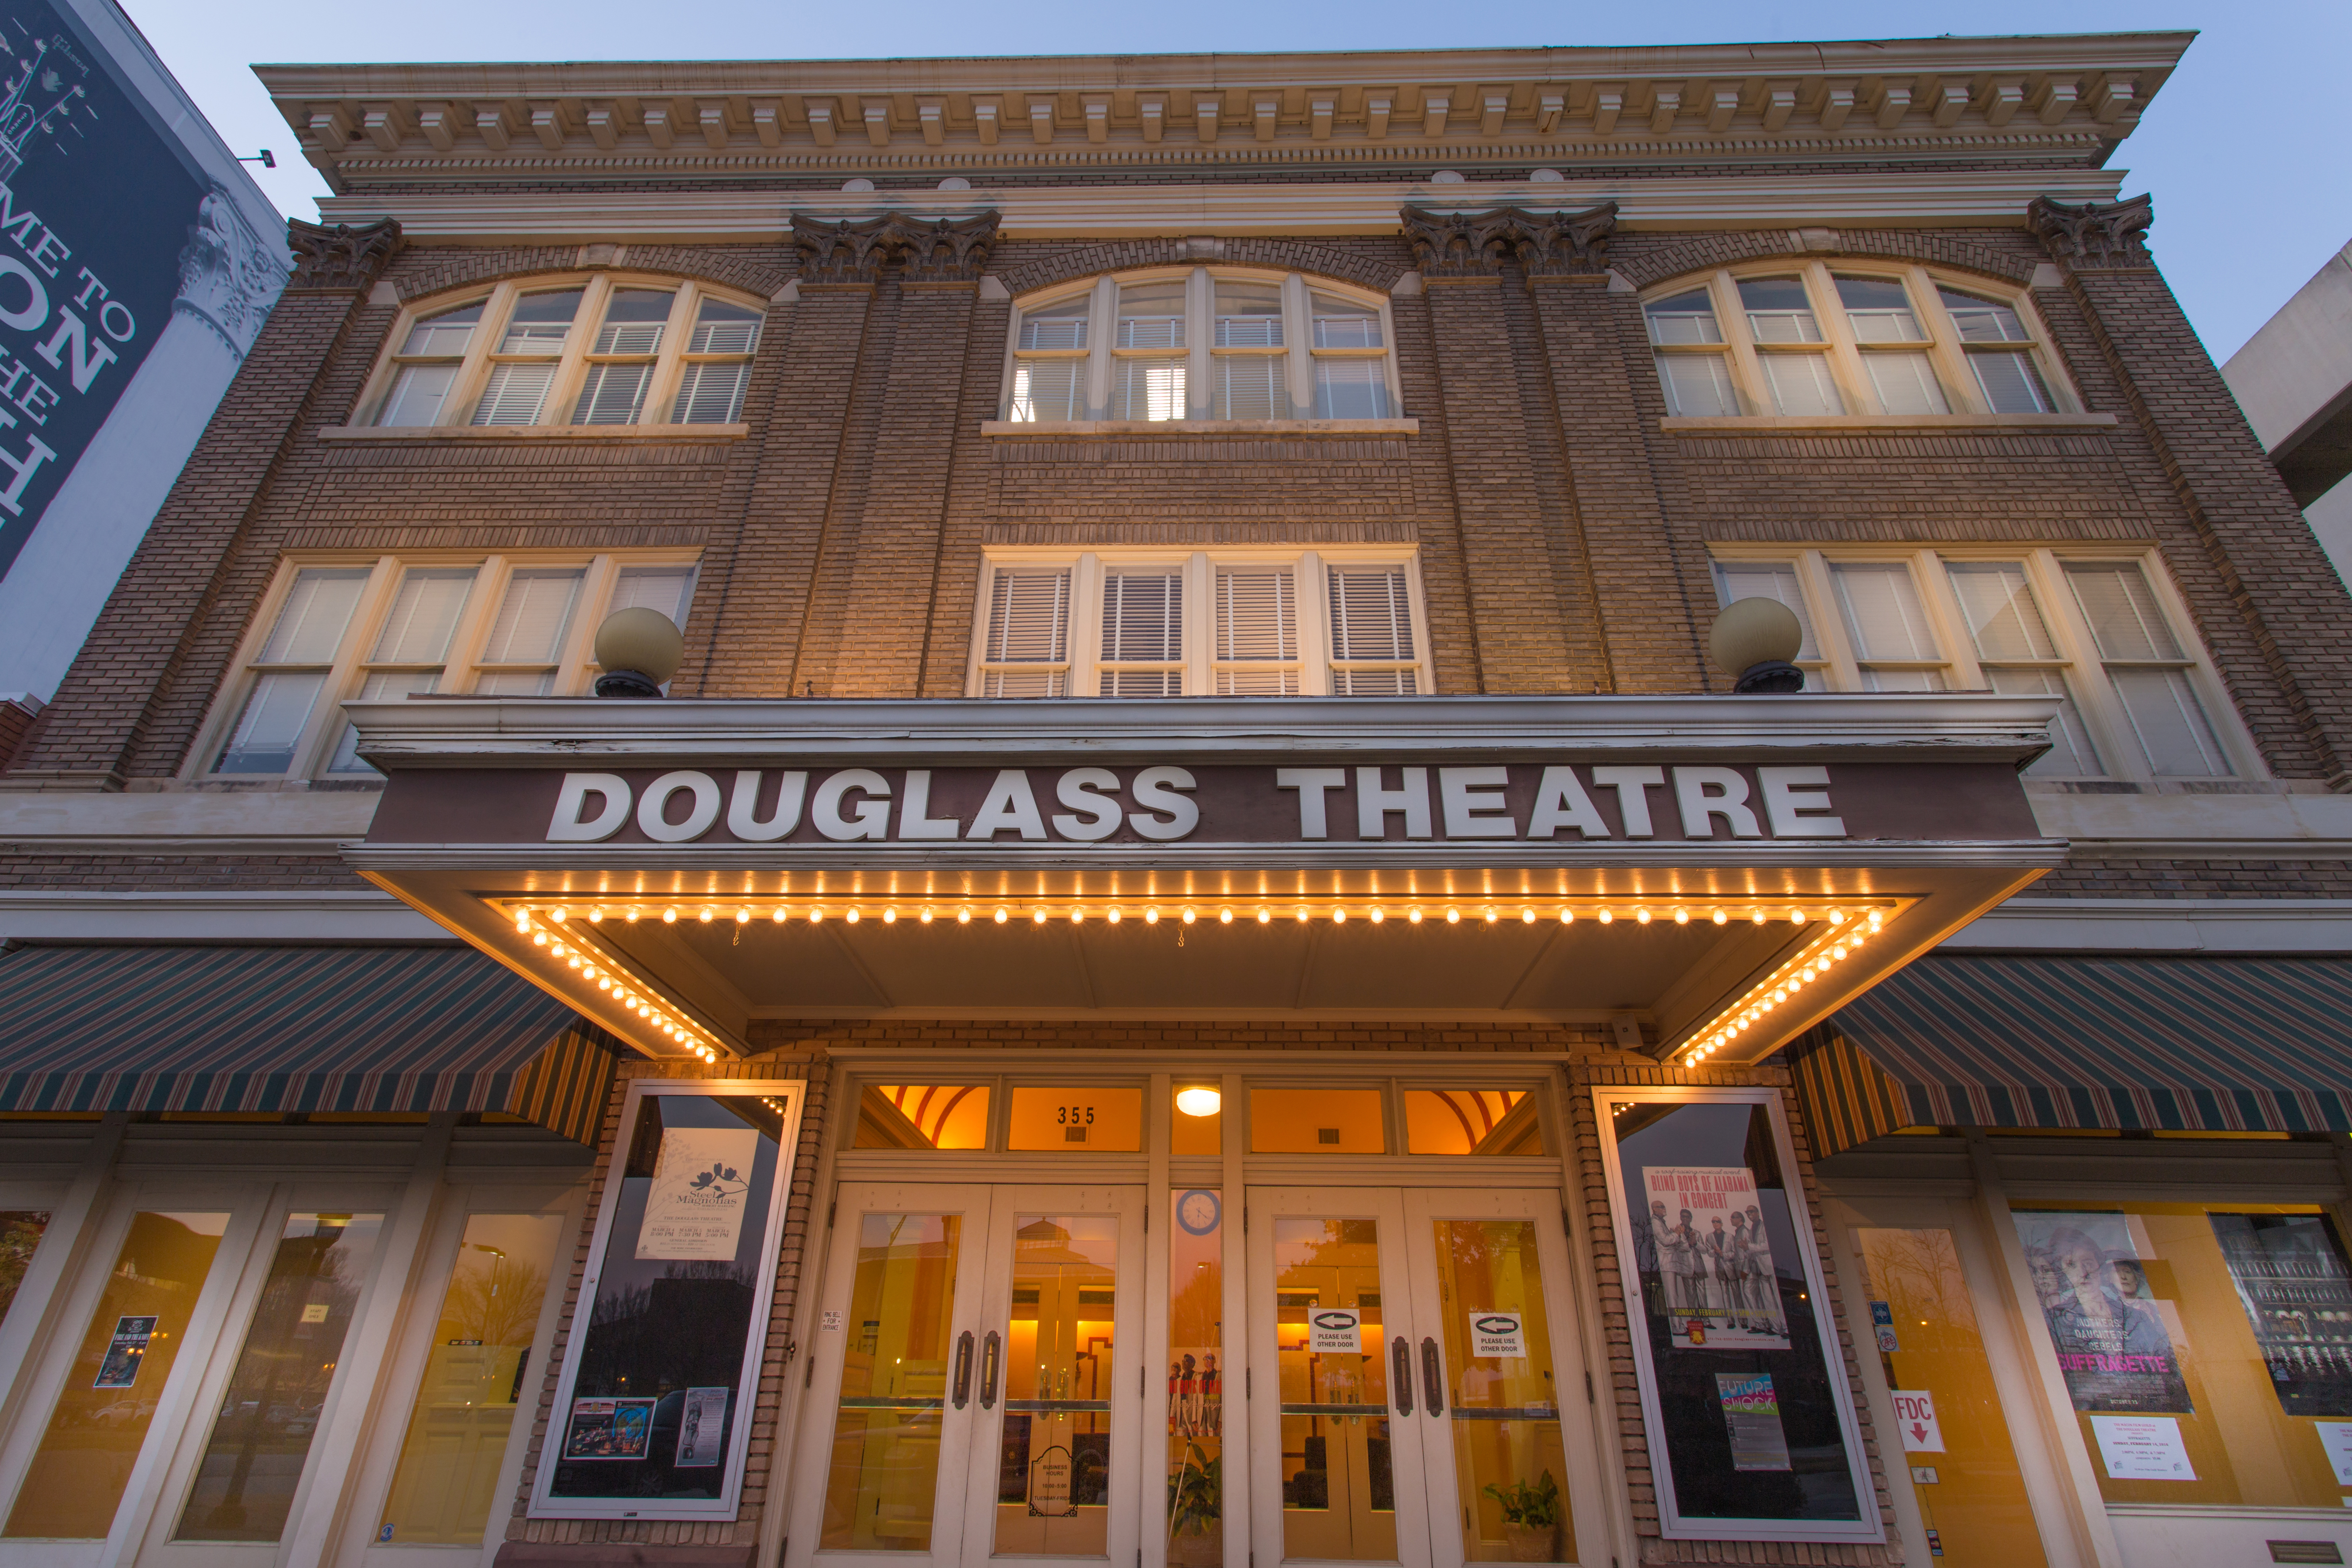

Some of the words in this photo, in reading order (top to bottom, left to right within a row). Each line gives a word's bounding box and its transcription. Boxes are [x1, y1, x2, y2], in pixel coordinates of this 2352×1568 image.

[50, 34, 90, 78] Gibson
[73, 266, 136, 342] TO
[545, 765, 1200, 843] DOUGLASS
[1276, 765, 1848, 840] THEATRE
[1057, 1106, 1095, 1125] 355
[1650, 1175, 1676, 1191] BLIND
[1677, 1175, 1699, 1191] BOYS
[1701, 1176, 1712, 1192] OF
[1714, 1176, 1750, 1192] ALABAMA
[676, 1195, 737, 1206] Magnolias
[1679, 1192, 1690, 1209] IN
[1691, 1192, 1728, 1209] CONCERT
[1674, 1308, 1698, 1317] SUNDAY,
[2056, 1353, 2169, 1373] SUFFRAGETTE
[1180, 1380, 1197, 1394] BOYS
[1199, 1380, 1207, 1394] OF
[1718, 1380, 1773, 1395] FUTURE
[1723, 1396, 1775, 1410] SHOCK
[1894, 1397, 1932, 1420] FDC
